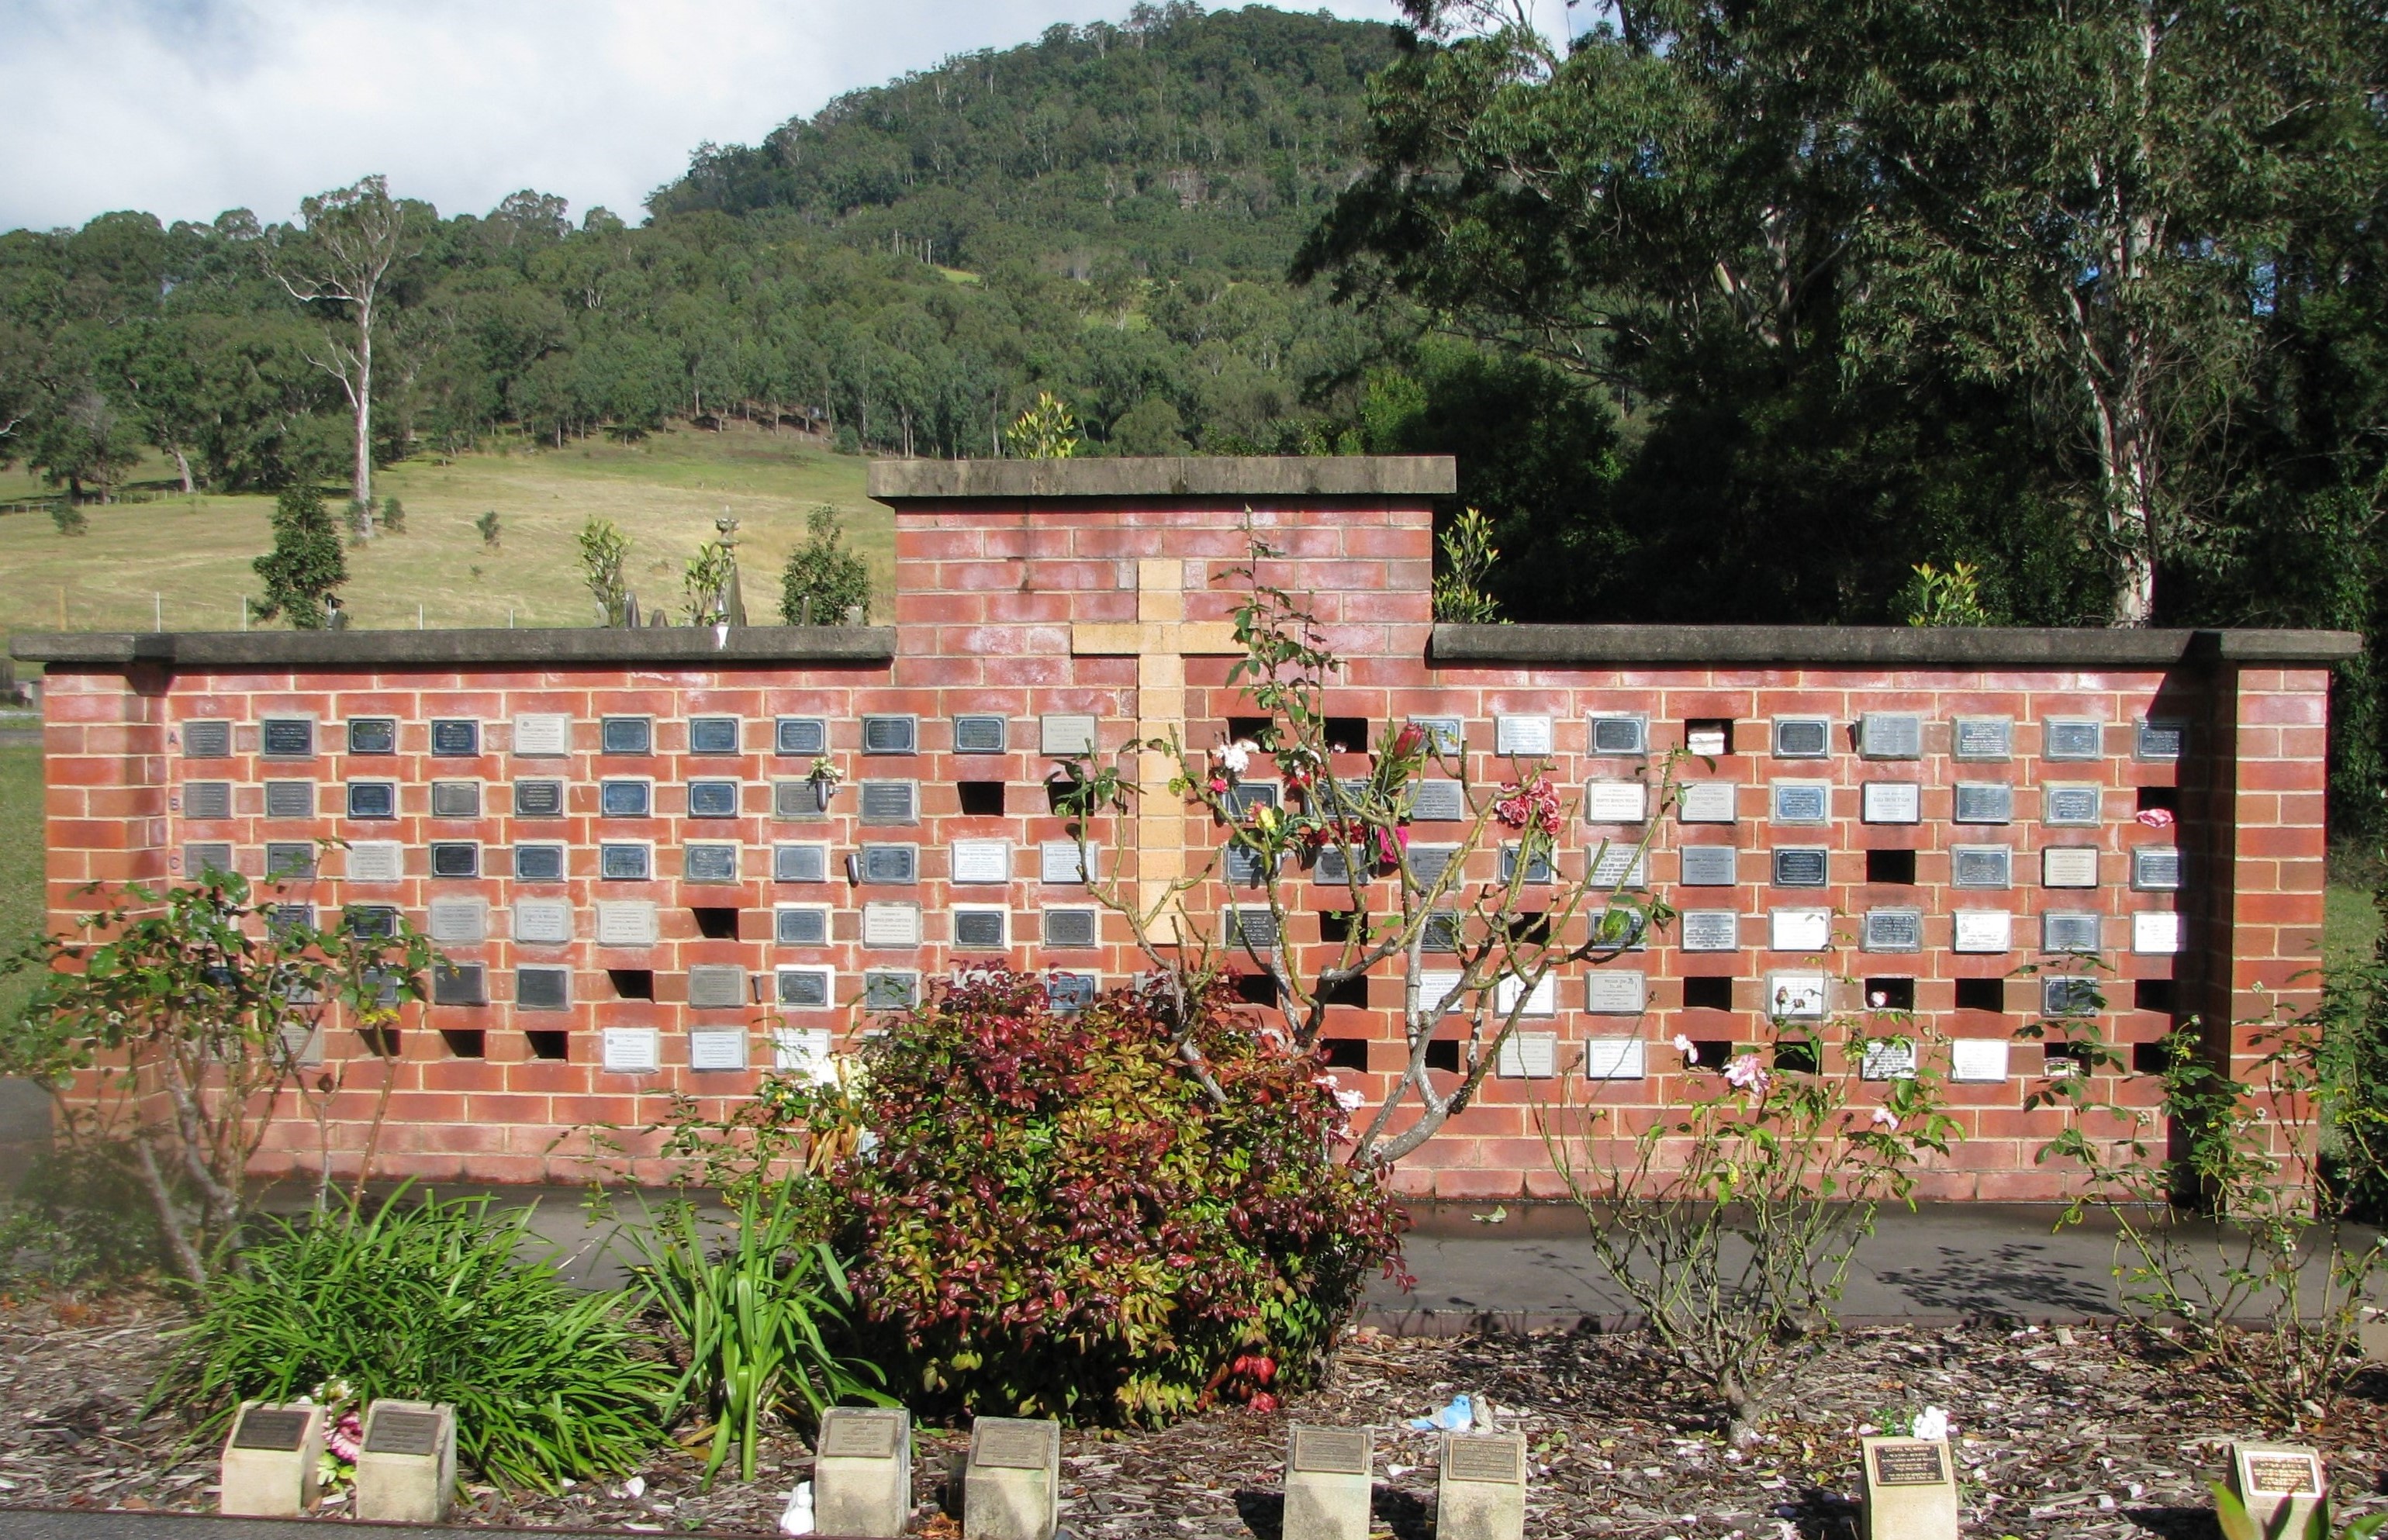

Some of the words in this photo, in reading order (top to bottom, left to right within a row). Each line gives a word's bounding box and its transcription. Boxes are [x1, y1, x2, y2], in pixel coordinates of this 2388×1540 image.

[168, 731, 178, 745] A
[170, 797, 179, 810] B
[170, 856, 180, 869] C
